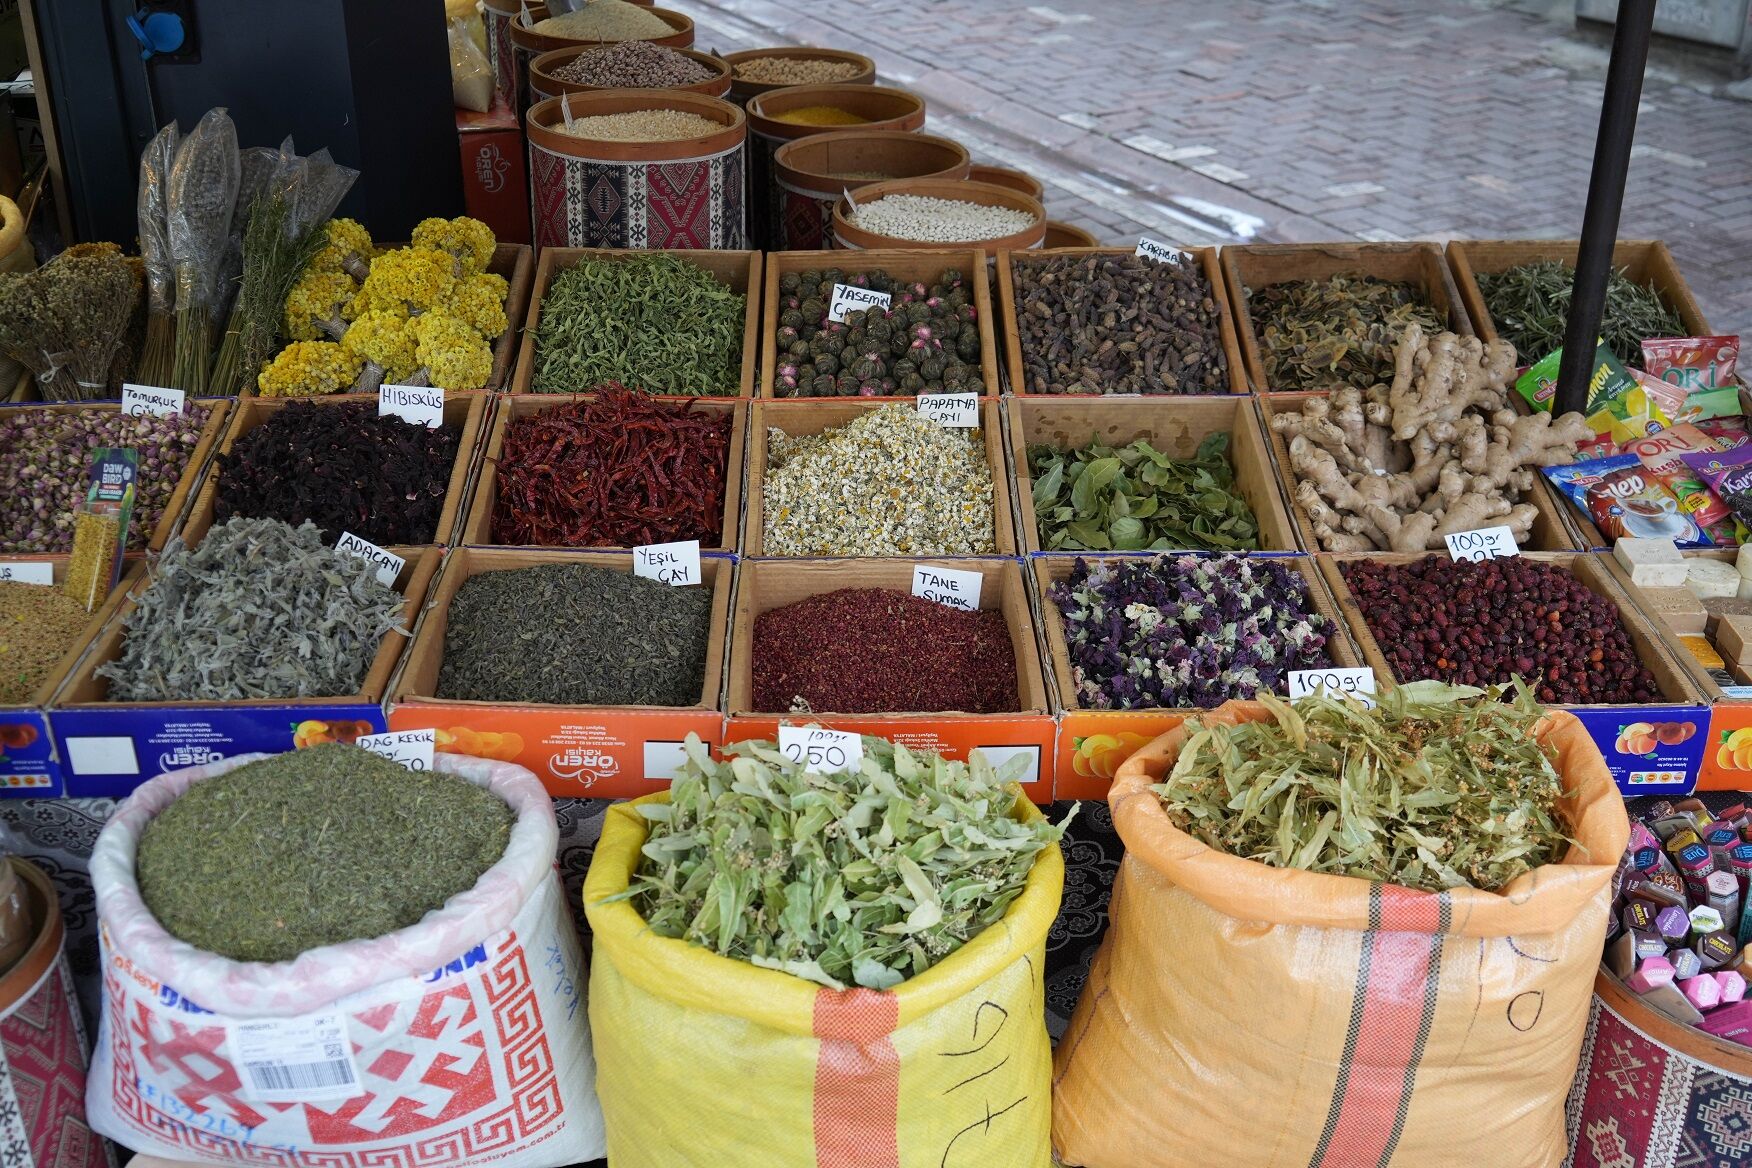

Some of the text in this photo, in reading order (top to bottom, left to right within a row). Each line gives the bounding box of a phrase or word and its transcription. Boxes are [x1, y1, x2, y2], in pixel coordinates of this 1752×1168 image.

[918, 396, 976, 411] PAPATYA
[929, 411, 961, 423] ÇAYI
[638, 548, 679, 566] YEŞİL
[658, 565, 689, 585] ÇAY
[918, 571, 960, 591] TANE
[786, 743, 846, 767] 250
